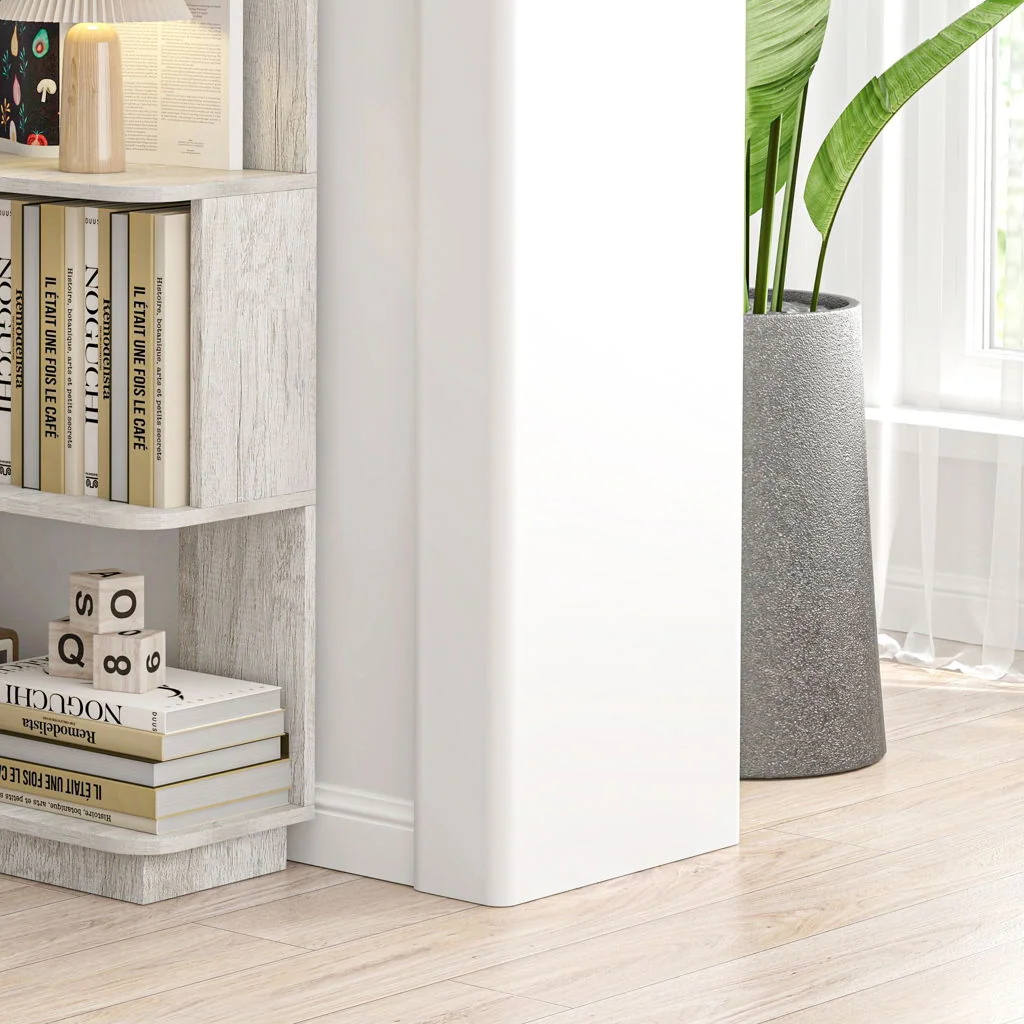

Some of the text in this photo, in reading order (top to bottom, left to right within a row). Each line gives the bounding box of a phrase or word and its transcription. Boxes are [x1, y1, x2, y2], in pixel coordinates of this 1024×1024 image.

[85, 264, 99, 425] NOGUCHI
[134, 286, 148, 451] IL ÉTAIT UNE FOIS LE CAFÉ
[57, 633, 85, 668] Q
[103, 654, 132, 676] 8
[5, 684, 123, 725] NOGUCHI
[22, 717, 97, 744] Remodelista
[9, 766, 21, 785] LE
[22, 770, 43, 789] FOIS
[45, 775, 64, 793] UNE
[4, 793, 24, 803] petits
[65, 778, 91, 802] ÉTAIT
[93, 783, 102, 801] IL
[32, 798, 47, 807] arts
